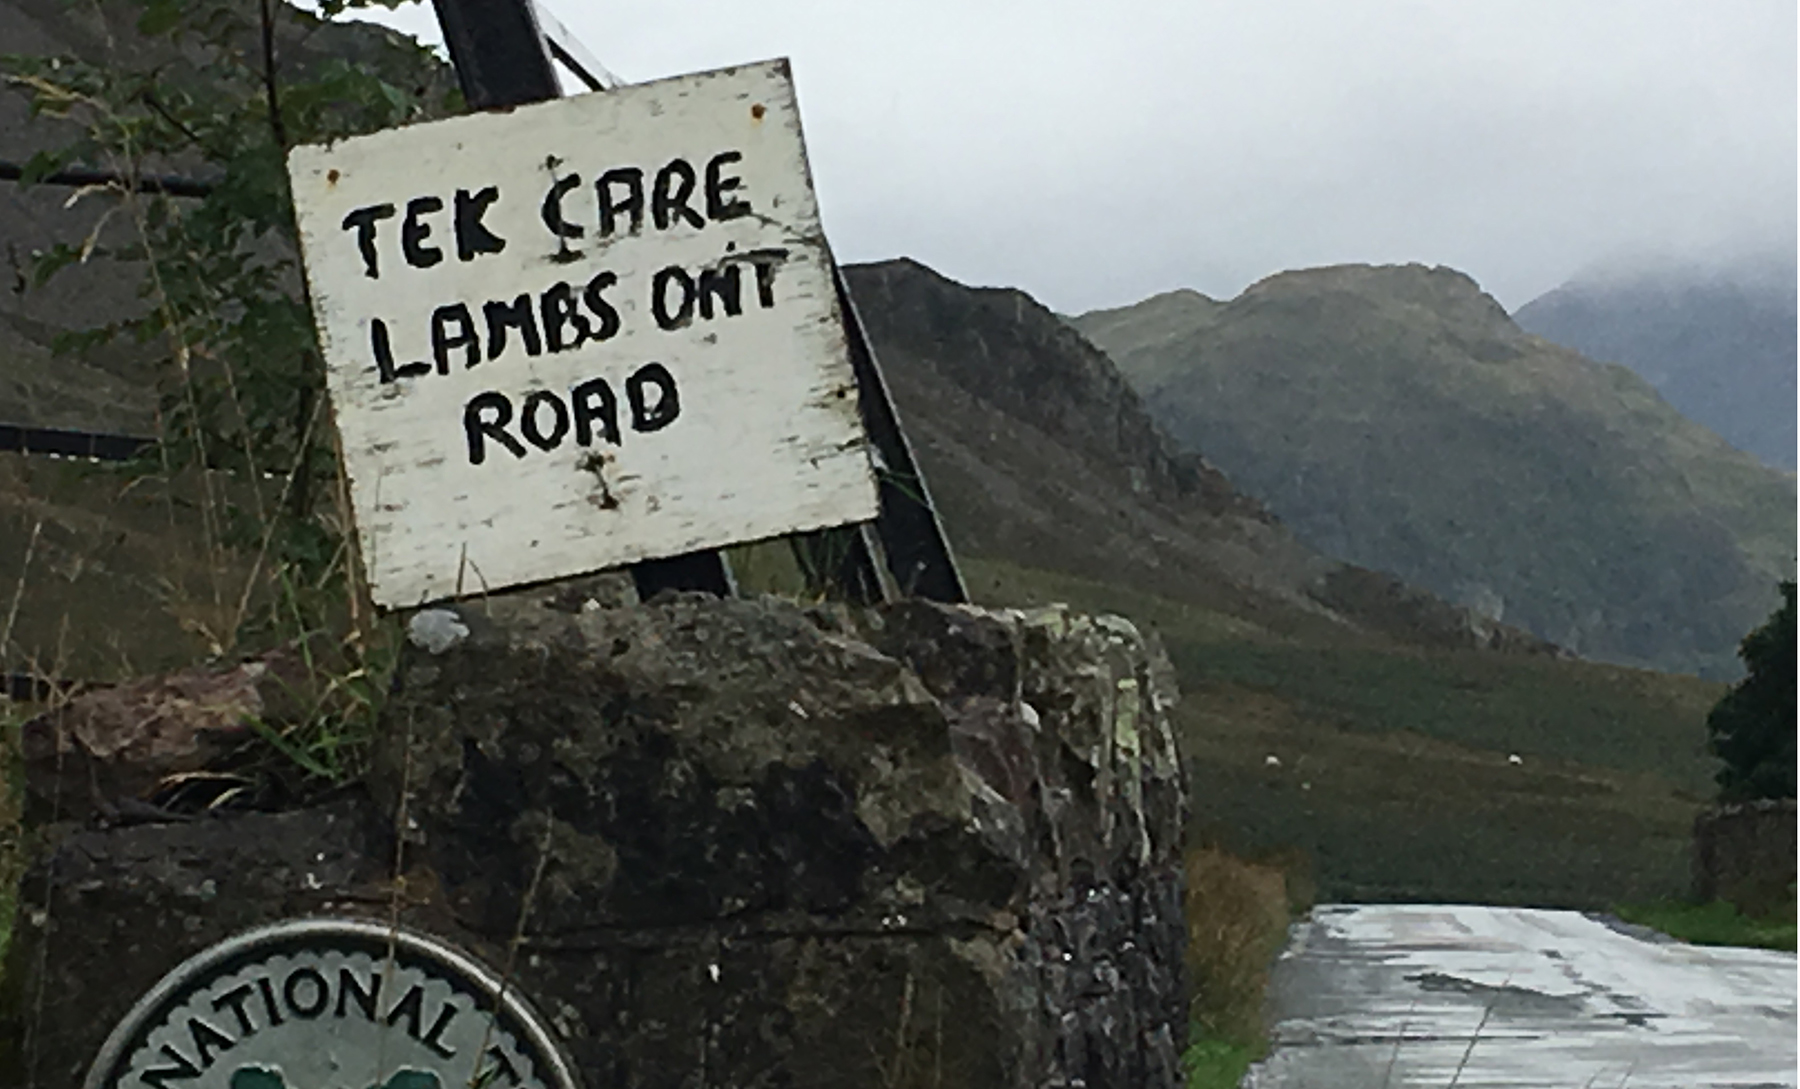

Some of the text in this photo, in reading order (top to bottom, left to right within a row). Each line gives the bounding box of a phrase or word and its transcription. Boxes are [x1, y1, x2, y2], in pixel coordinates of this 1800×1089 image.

[342, 151, 751, 279] TEK CARE
[370, 247, 789, 384] LAMBS ONT
[462, 362, 681, 465] ROAD
[139, 967, 458, 1089] NATIONAL
